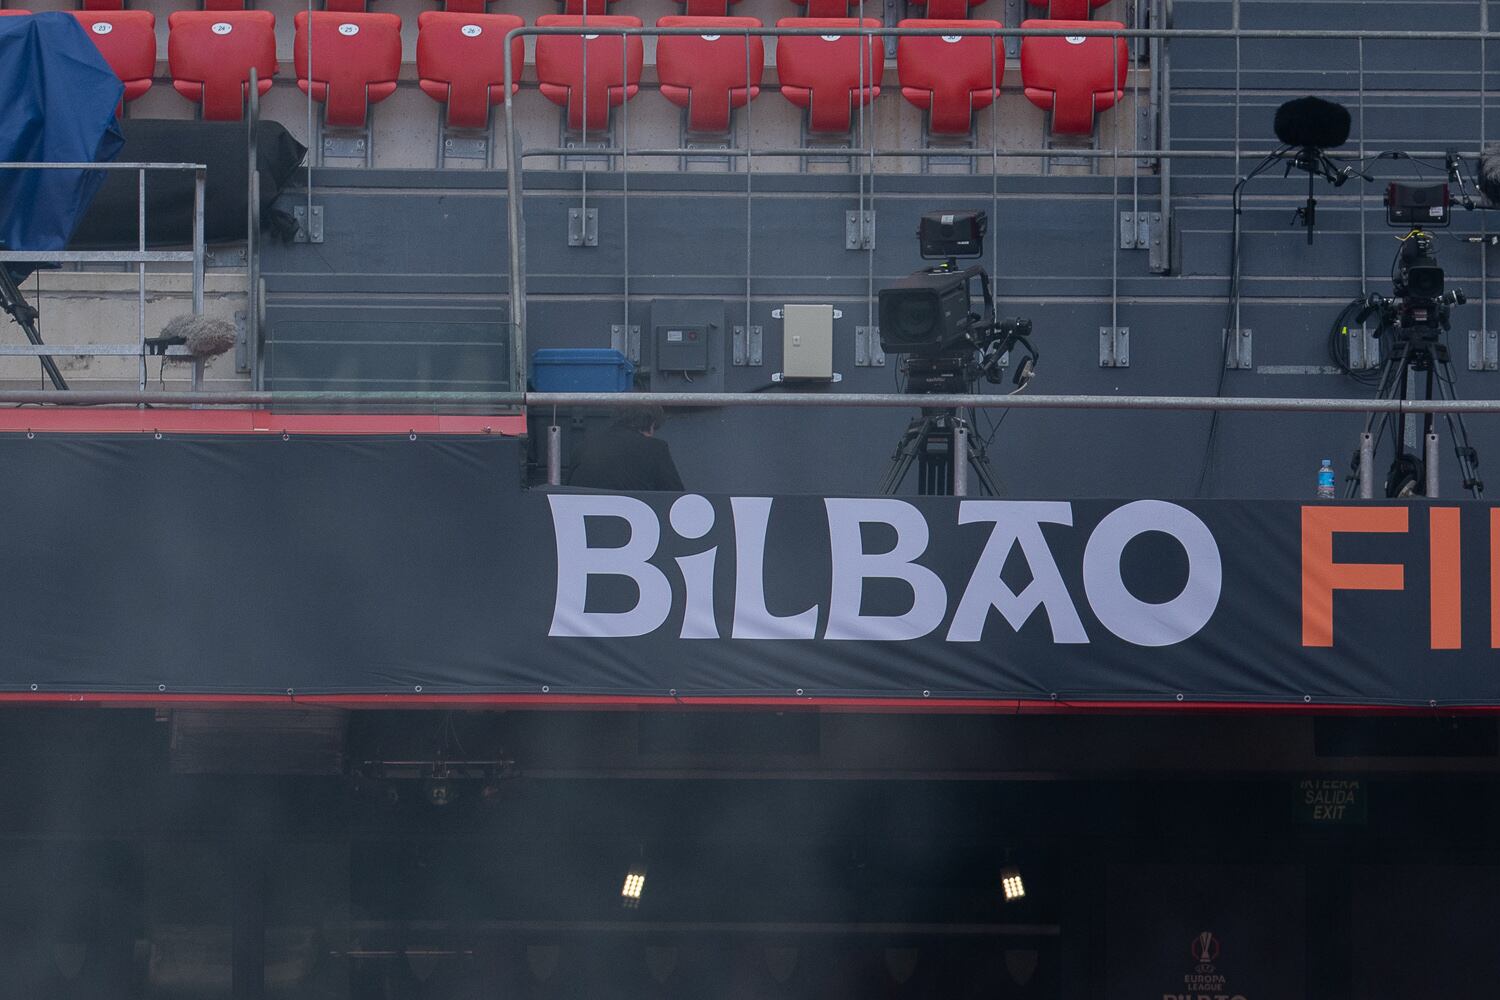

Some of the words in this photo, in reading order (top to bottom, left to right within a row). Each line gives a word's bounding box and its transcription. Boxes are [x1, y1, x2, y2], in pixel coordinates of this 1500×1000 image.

[1305, 790, 1354, 804] SALIDA
[1312, 805, 1346, 820] EXIT
[1184, 975, 1226, 983] EUROPA
[1188, 983, 1222, 991] LEAGUE
